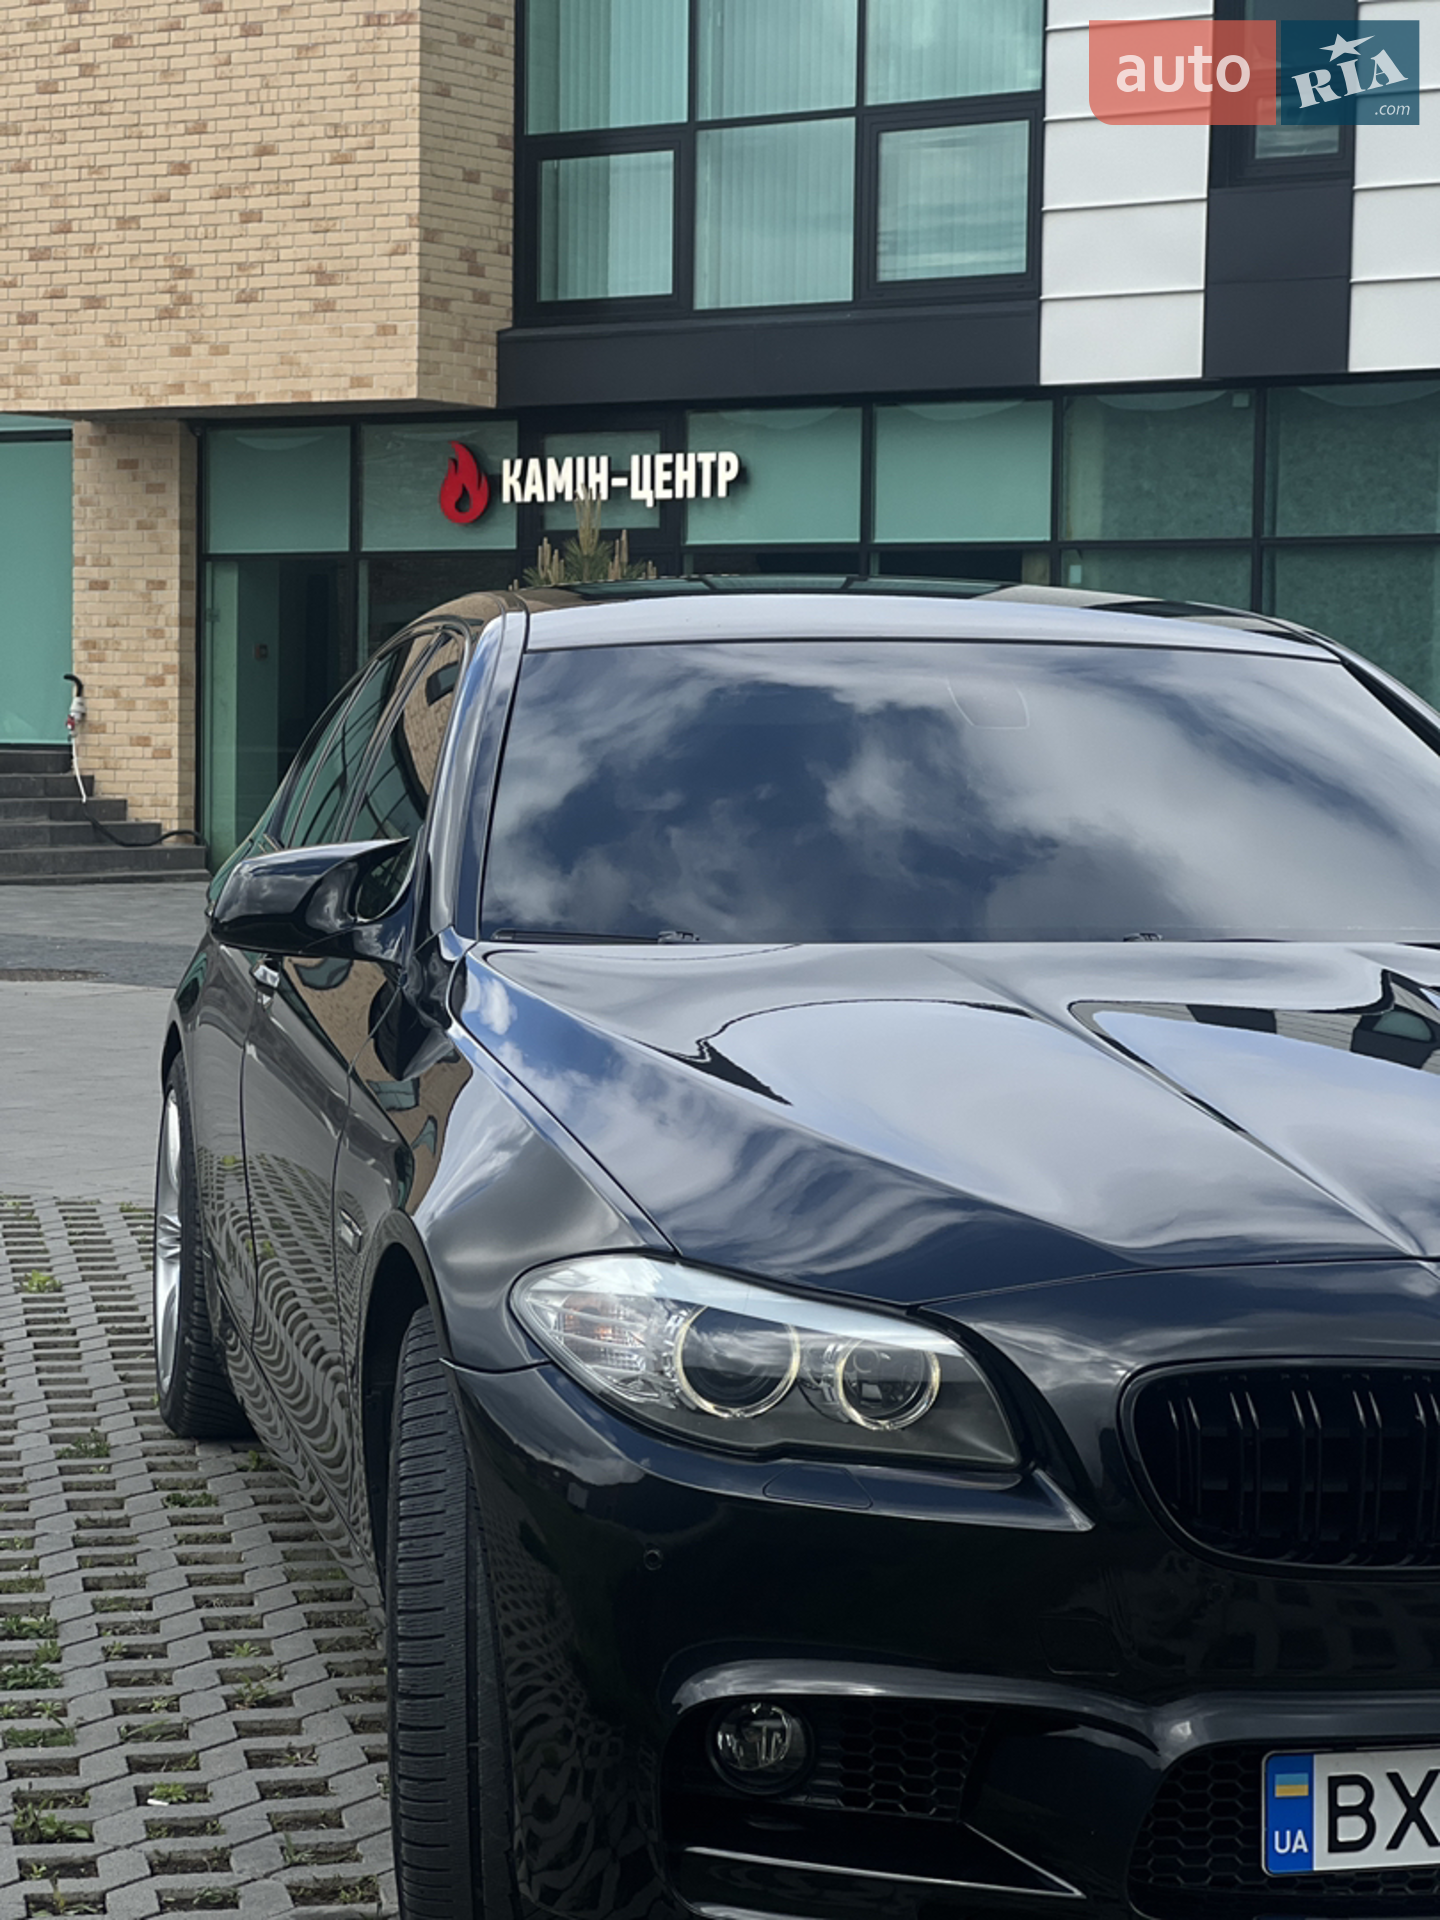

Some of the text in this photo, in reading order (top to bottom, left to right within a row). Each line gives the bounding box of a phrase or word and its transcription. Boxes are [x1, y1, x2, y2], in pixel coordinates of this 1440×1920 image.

[502, 451, 740, 508] КАМІН-ЦЕНТР
[1327, 1769, 1440, 1853] BX
[1274, 1829, 1309, 1854] UA
